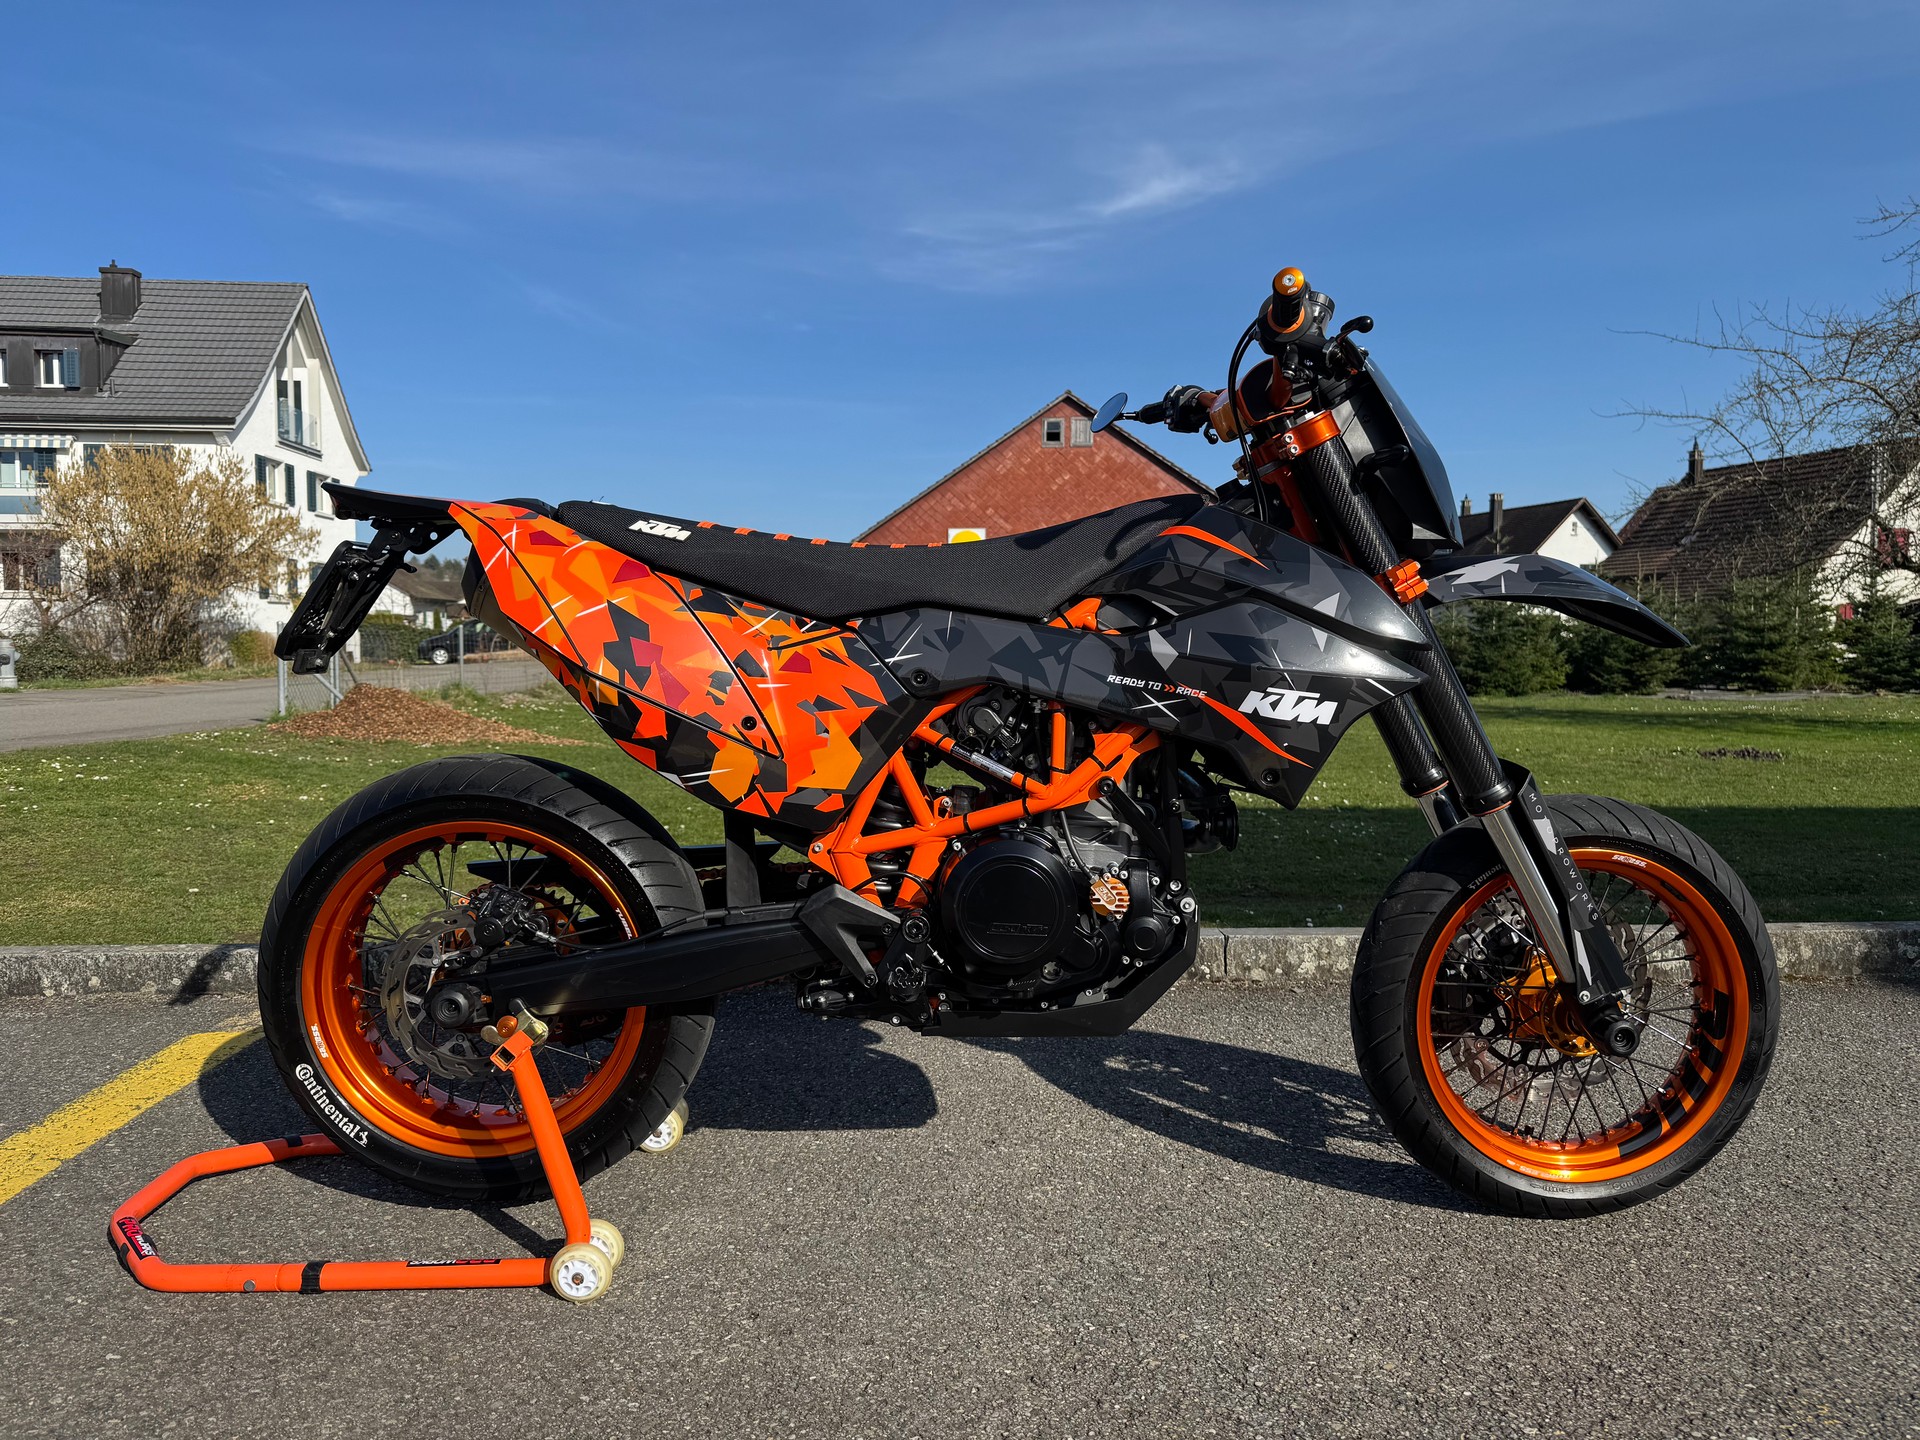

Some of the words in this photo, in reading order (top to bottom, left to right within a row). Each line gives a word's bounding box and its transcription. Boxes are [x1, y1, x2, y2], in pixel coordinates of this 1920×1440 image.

[628, 519, 692, 541] KTM
[1106, 674, 1145, 688] READY
[1147, 680, 1162, 691] TO
[1175, 686, 1208, 699] RACE
[1238, 687, 1339, 725] KTM
[295, 1063, 361, 1139] Continental
